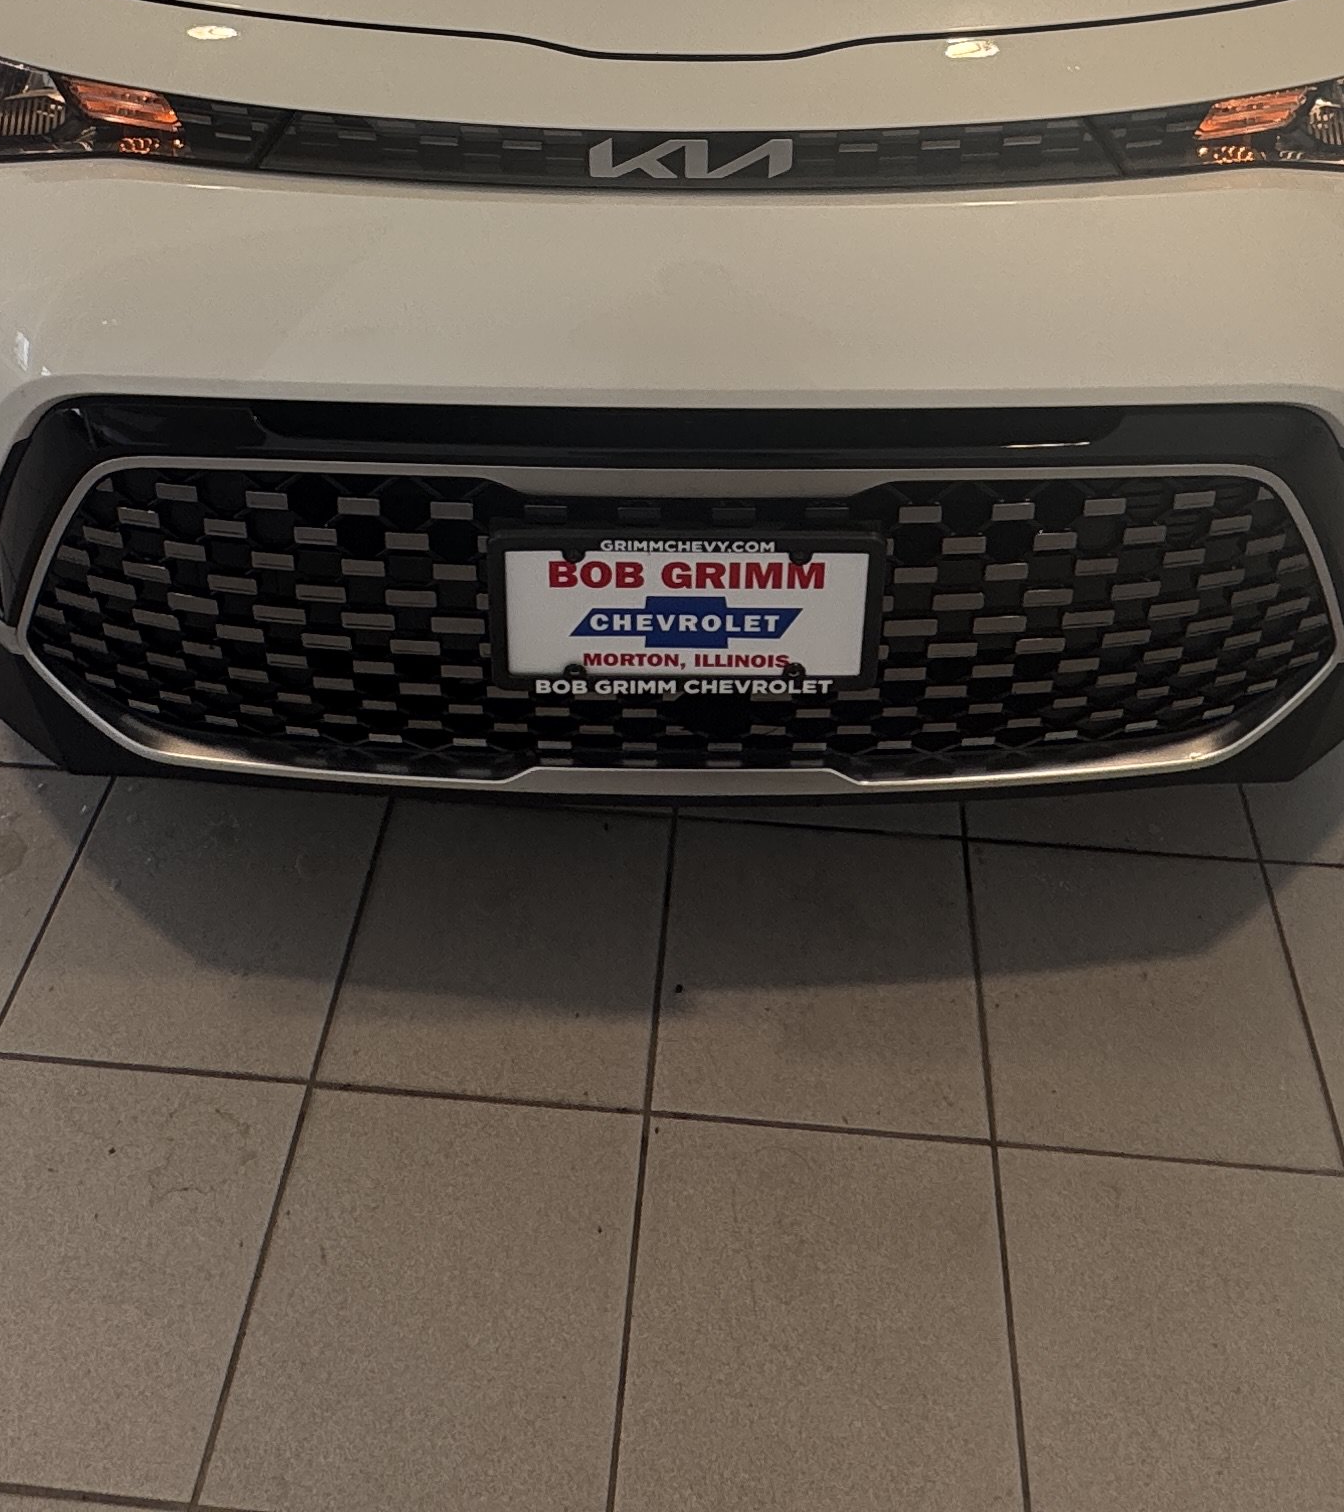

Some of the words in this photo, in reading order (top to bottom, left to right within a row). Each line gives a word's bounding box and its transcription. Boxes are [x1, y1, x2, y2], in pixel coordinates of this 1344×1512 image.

[589, 138, 793, 178] KIA
[600, 539, 776, 553] GRIMMCHEVY.COM
[548, 561, 645, 589] BOB
[661, 561, 826, 590] GRIMM
[589, 614, 780, 632] CHEVROLET
[583, 653, 686, 670] MORTON,
[694, 654, 790, 668] ILLINOIS
[535, 679, 587, 694] BOB
[594, 680, 677, 694] GRIMM
[684, 680, 833, 694] CHEVROLET
